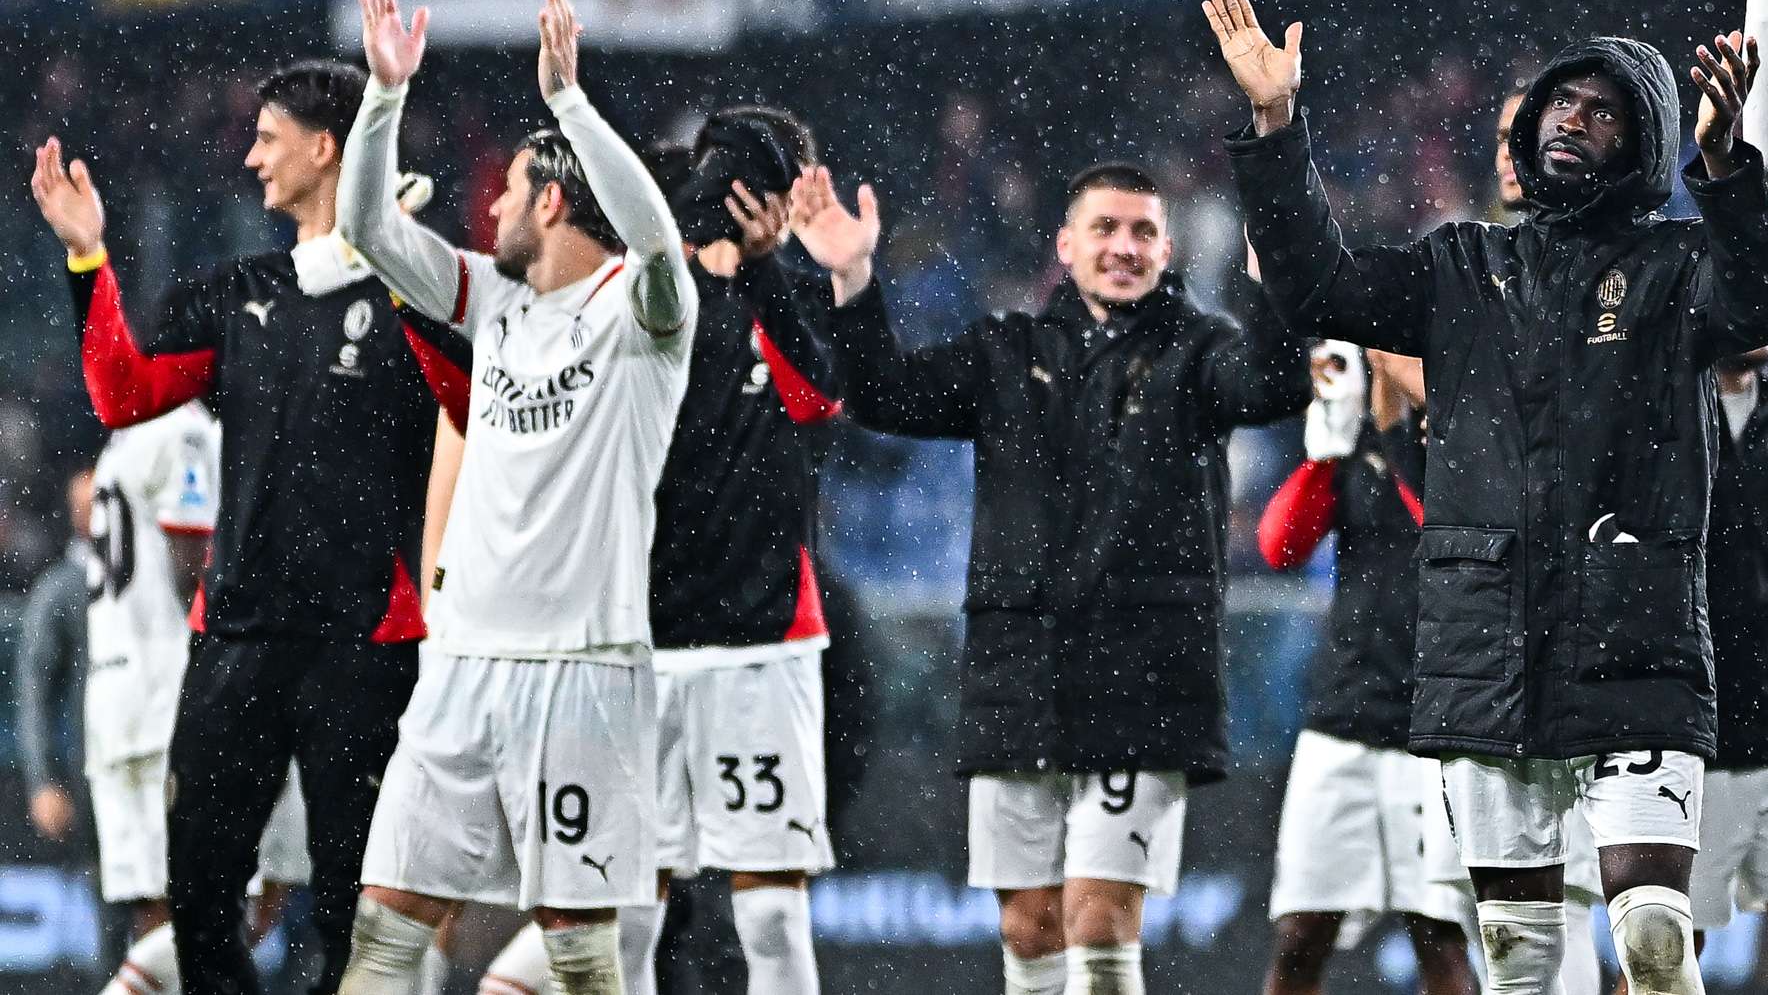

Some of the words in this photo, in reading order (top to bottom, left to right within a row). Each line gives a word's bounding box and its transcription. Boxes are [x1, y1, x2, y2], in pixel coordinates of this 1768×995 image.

[507, 399, 573, 434] BETTER
[717, 755, 784, 813] 33
[1101, 767, 1136, 815] 9
[538, 780, 589, 844] 19
